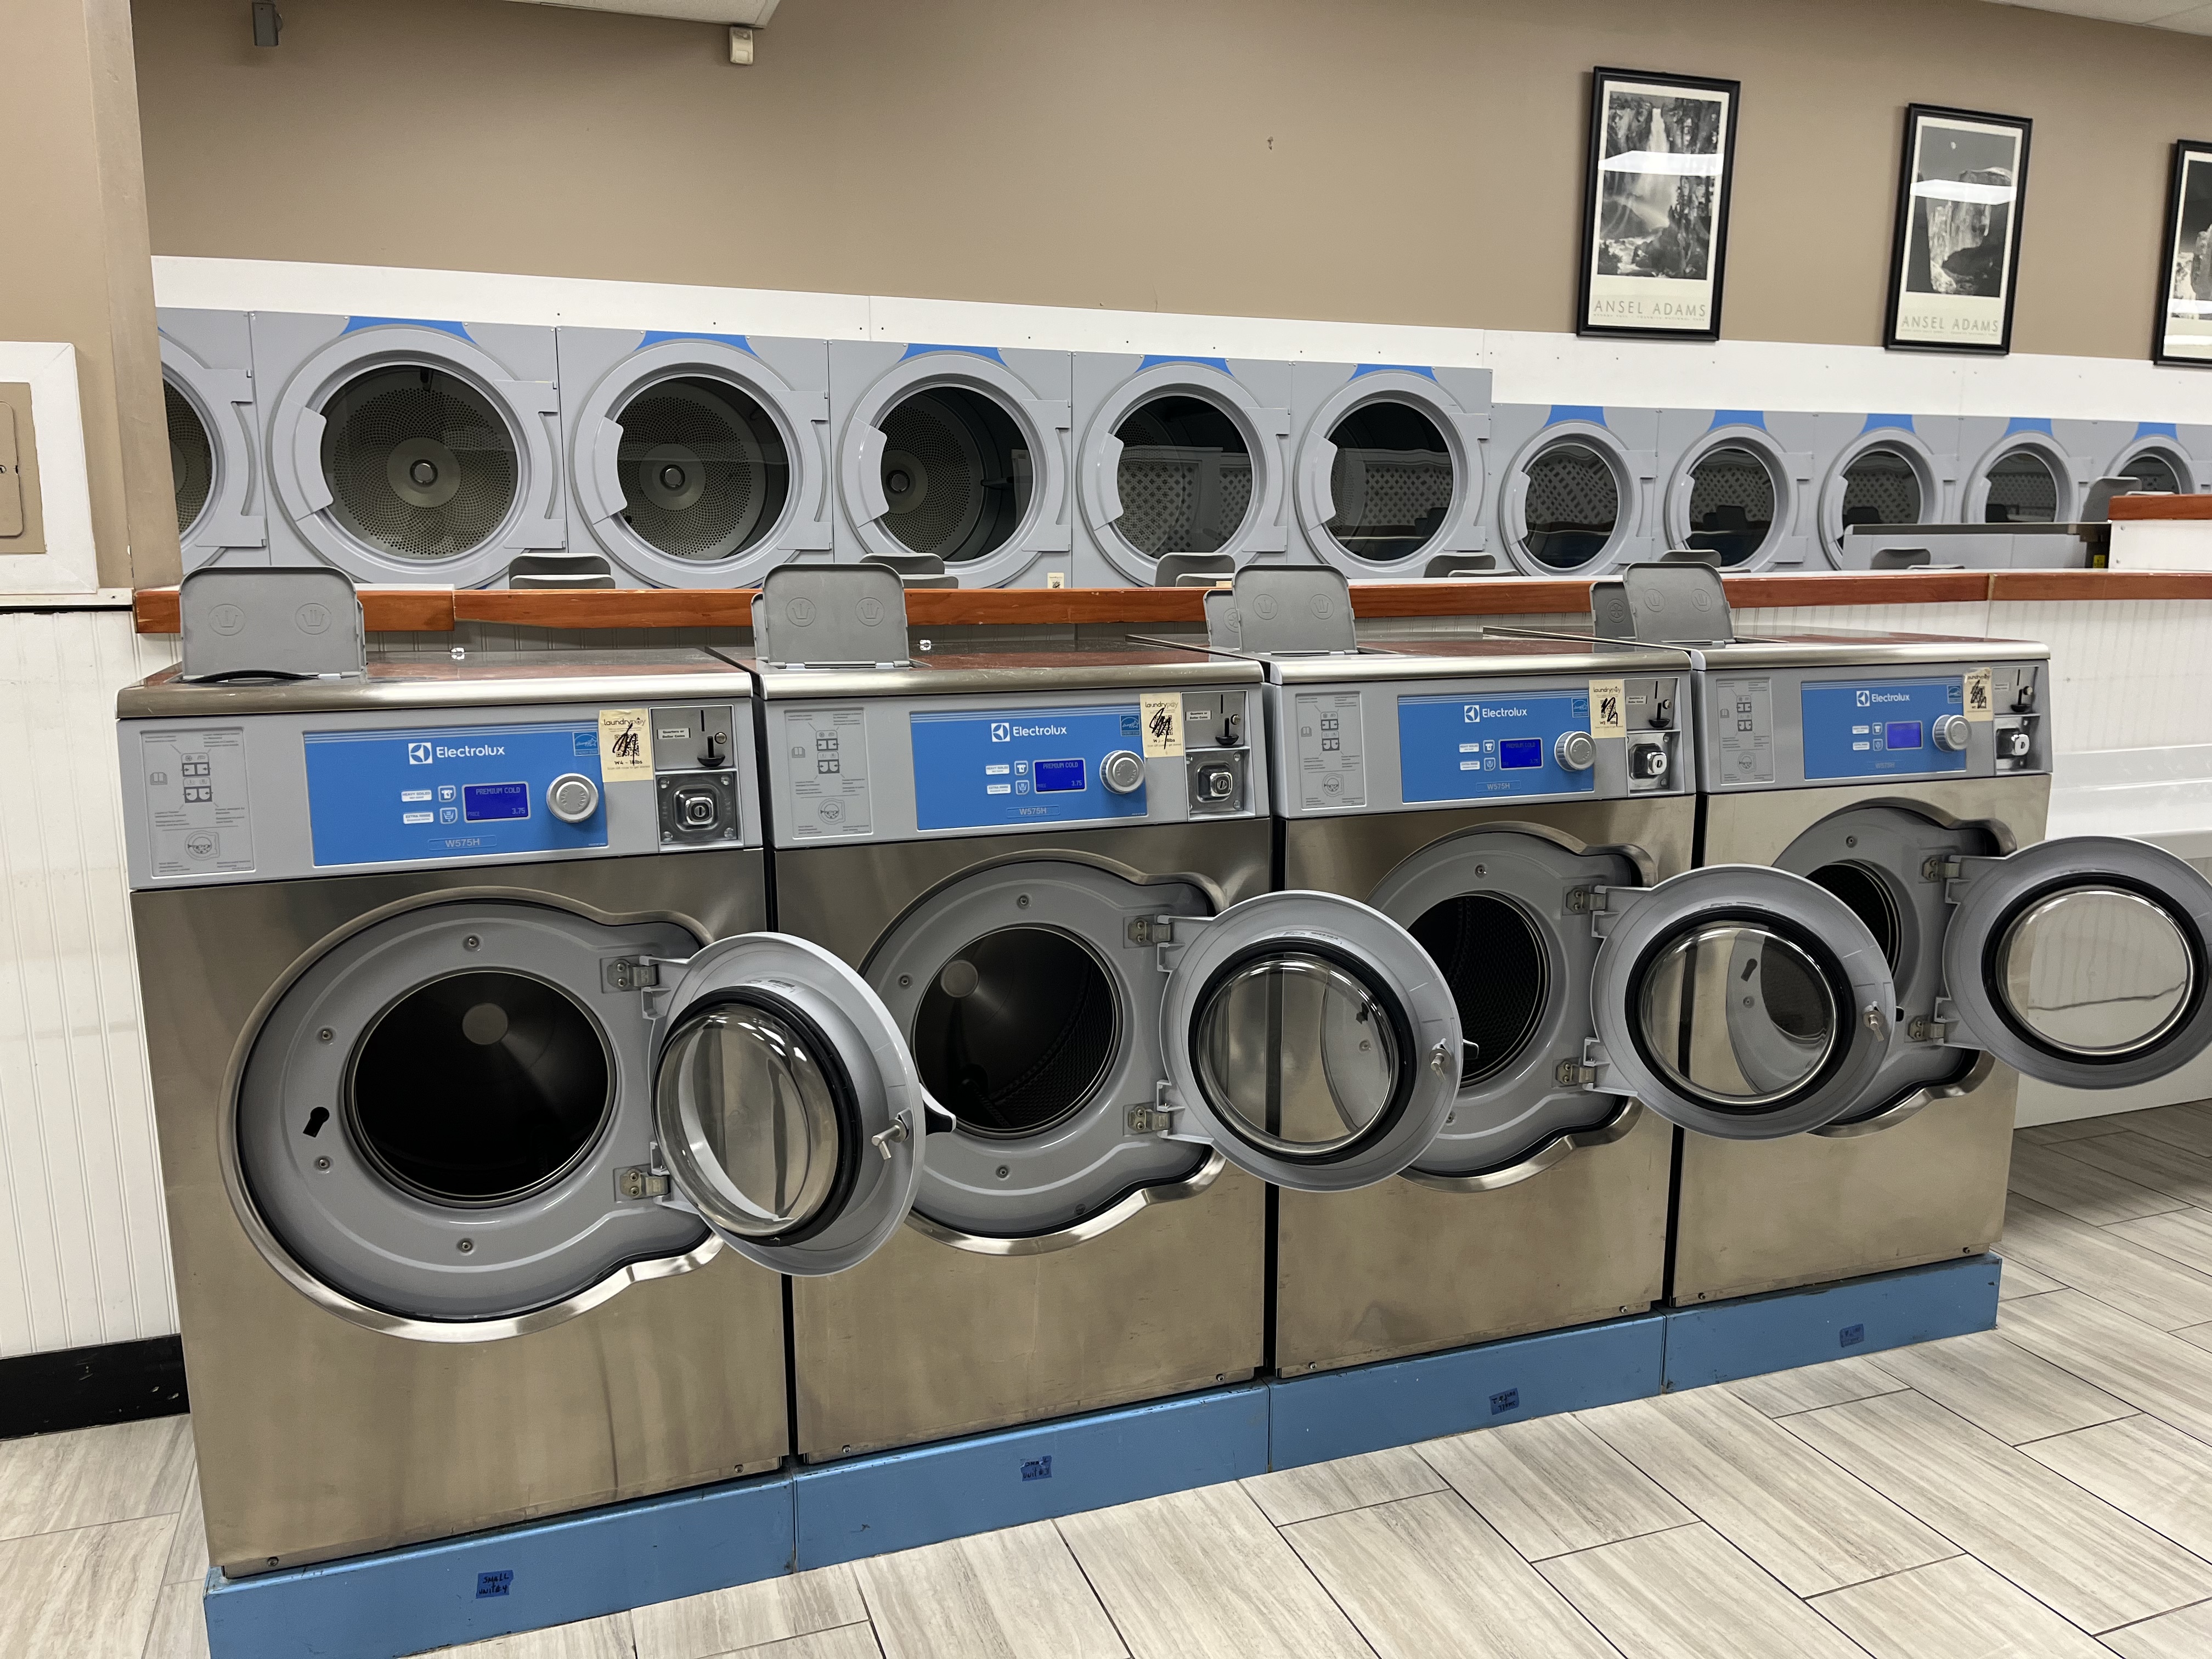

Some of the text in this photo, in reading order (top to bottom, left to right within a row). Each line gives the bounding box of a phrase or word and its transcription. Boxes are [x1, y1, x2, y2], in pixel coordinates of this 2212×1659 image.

[1594, 300, 1643, 314] ANSEL
[1652, 302, 1706, 317] ADAMS
[1901, 315, 1999, 332] ANSEL ADAMS
[1593, 686, 1622, 694] laundrypay
[1871, 692, 1910, 703] Electrolux
[1145, 701, 1179, 709] laundrypay
[1482, 707, 1527, 718] Electrolux
[603, 717, 646, 727] laundrypay
[1013, 725, 1067, 737] Electrolux
[436, 744, 505, 758] Electrolux
[476, 786, 521, 795] PREMIUM COLD
[1487, 782, 1510, 791] W575H
[511, 807, 526, 815] 3.75
[1019, 806, 1047, 815] W575H
[445, 838, 480, 848] W575H
